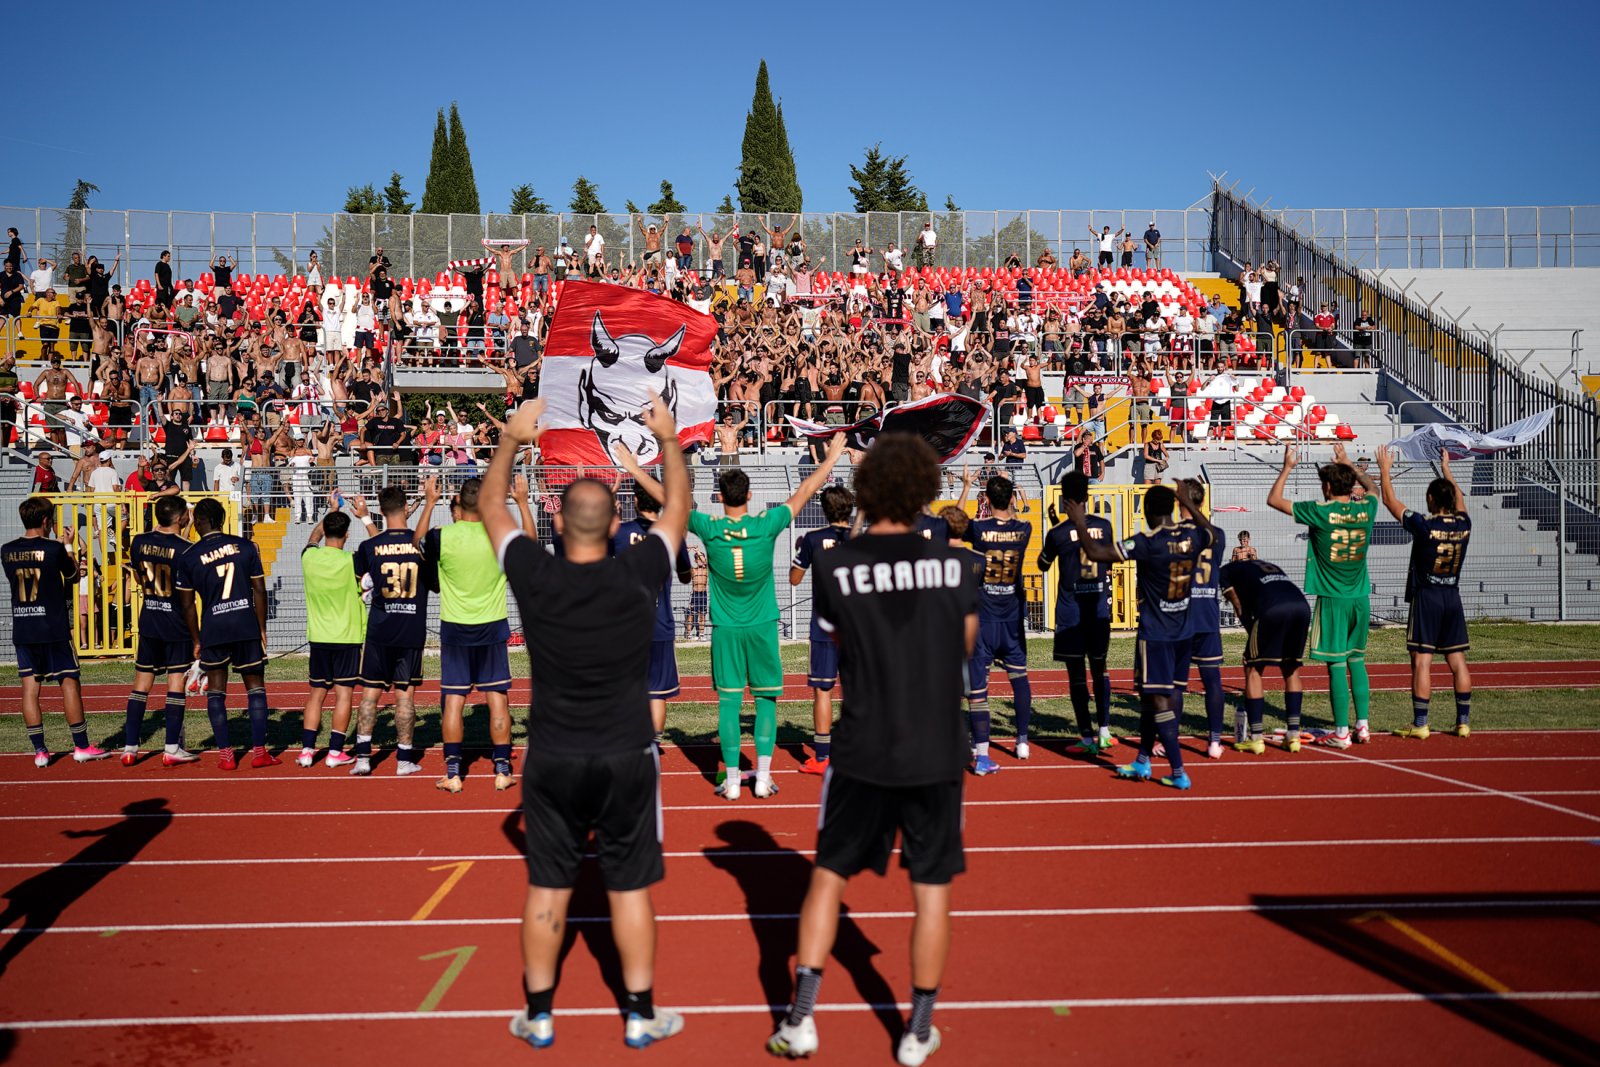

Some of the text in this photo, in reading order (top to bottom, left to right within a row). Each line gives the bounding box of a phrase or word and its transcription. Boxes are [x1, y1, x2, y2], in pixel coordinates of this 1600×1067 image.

[200, 543, 240, 565] NJAMBE
[1330, 529, 1366, 562] 22
[1433, 543, 1462, 574] 21
[731, 546, 744, 580] 1
[833, 558, 962, 596] TERAMO
[984, 549, 1020, 584] 68
[15, 568, 41, 602] 17
[216, 562, 235, 600] 7
[380, 562, 419, 599] 30
[211, 599, 249, 612] interno83
